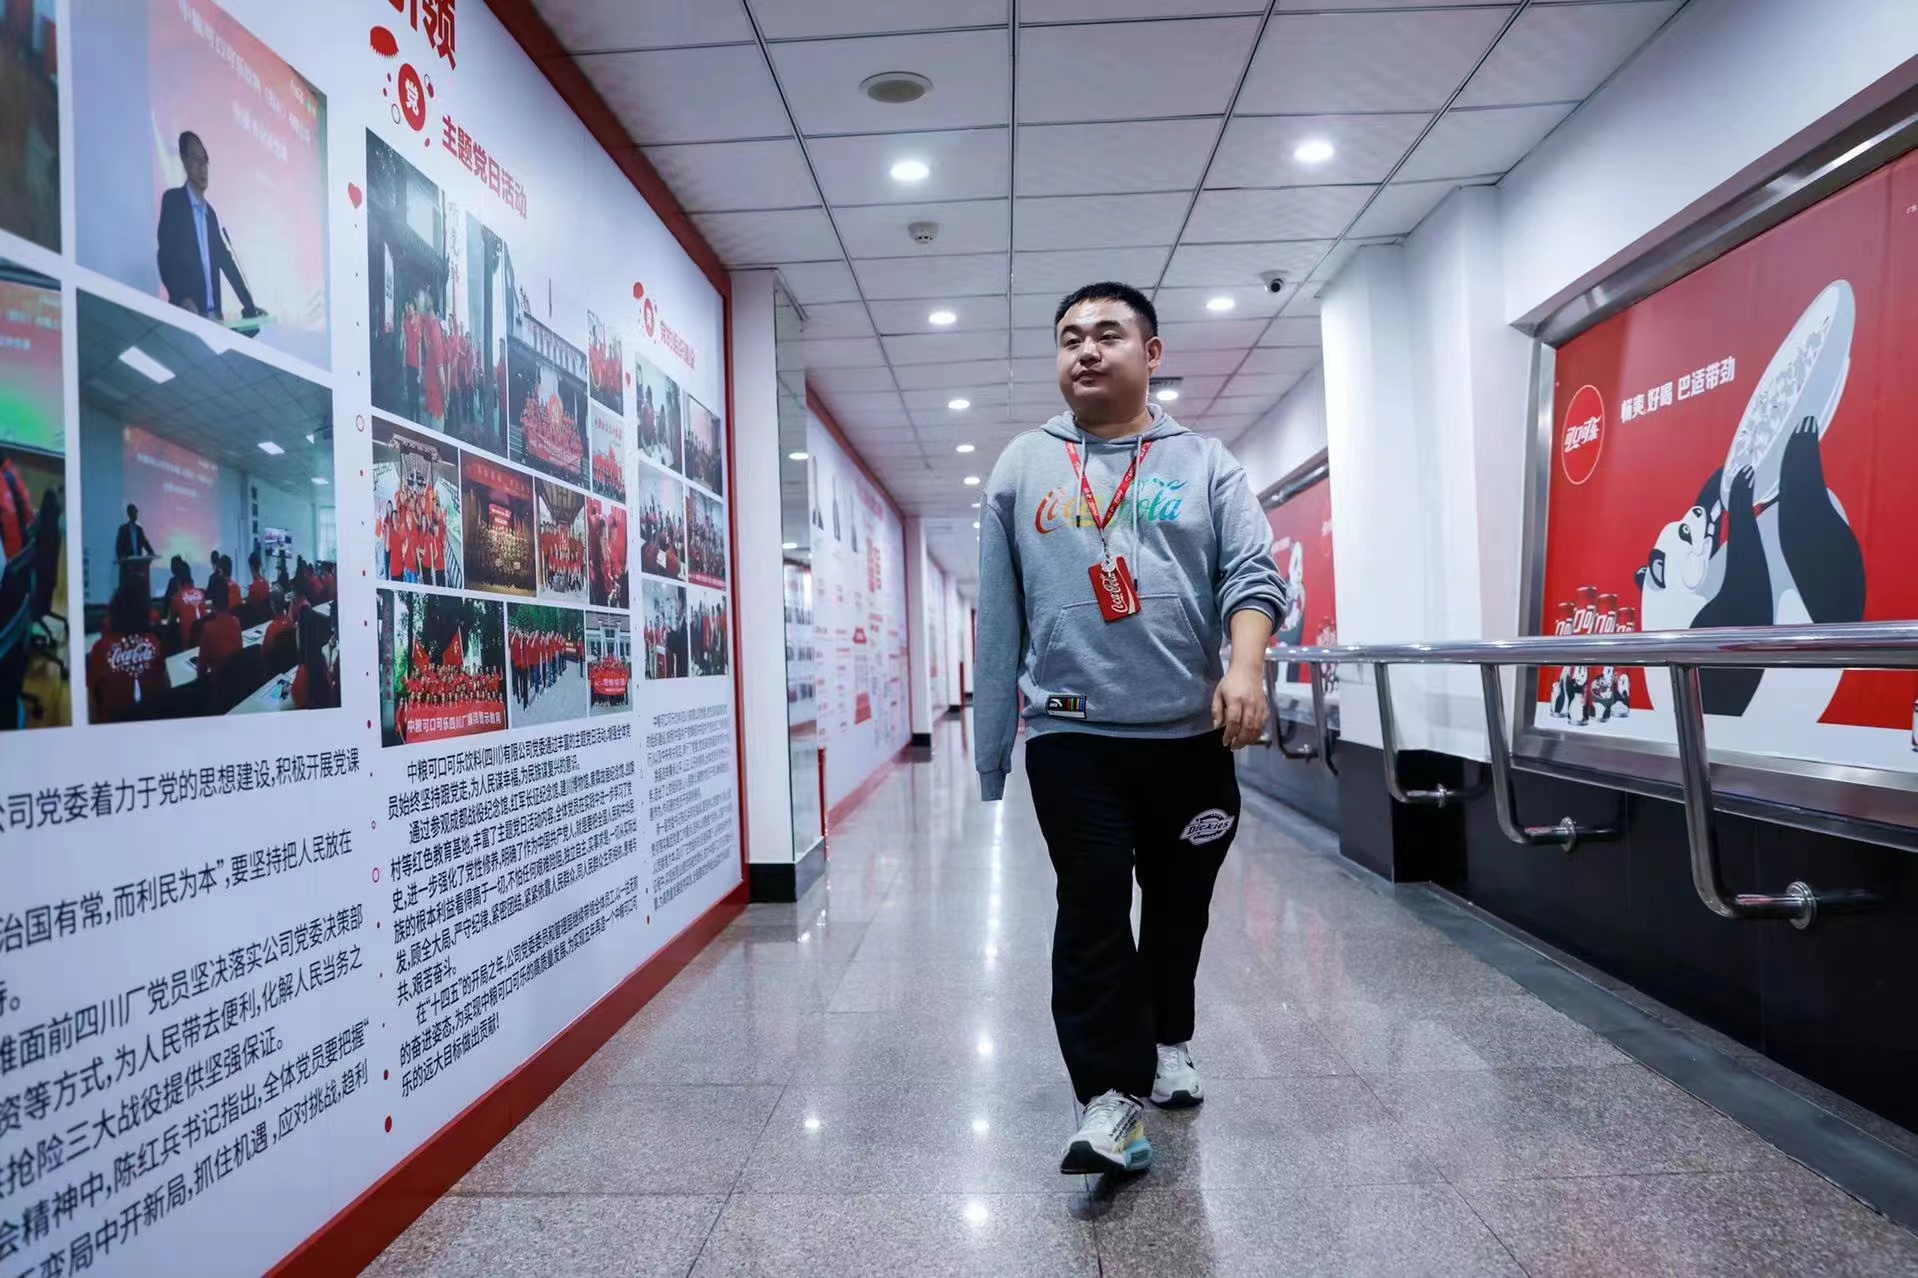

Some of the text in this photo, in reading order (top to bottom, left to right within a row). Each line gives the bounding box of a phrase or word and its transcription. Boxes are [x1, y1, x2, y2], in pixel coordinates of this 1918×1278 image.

[442, 115, 527, 219] 主题党日活动
[1678, 355, 1736, 400] 巴适带劲
[0, 1020, 284, 1203] 抢险三大战役提供坚强保证。
